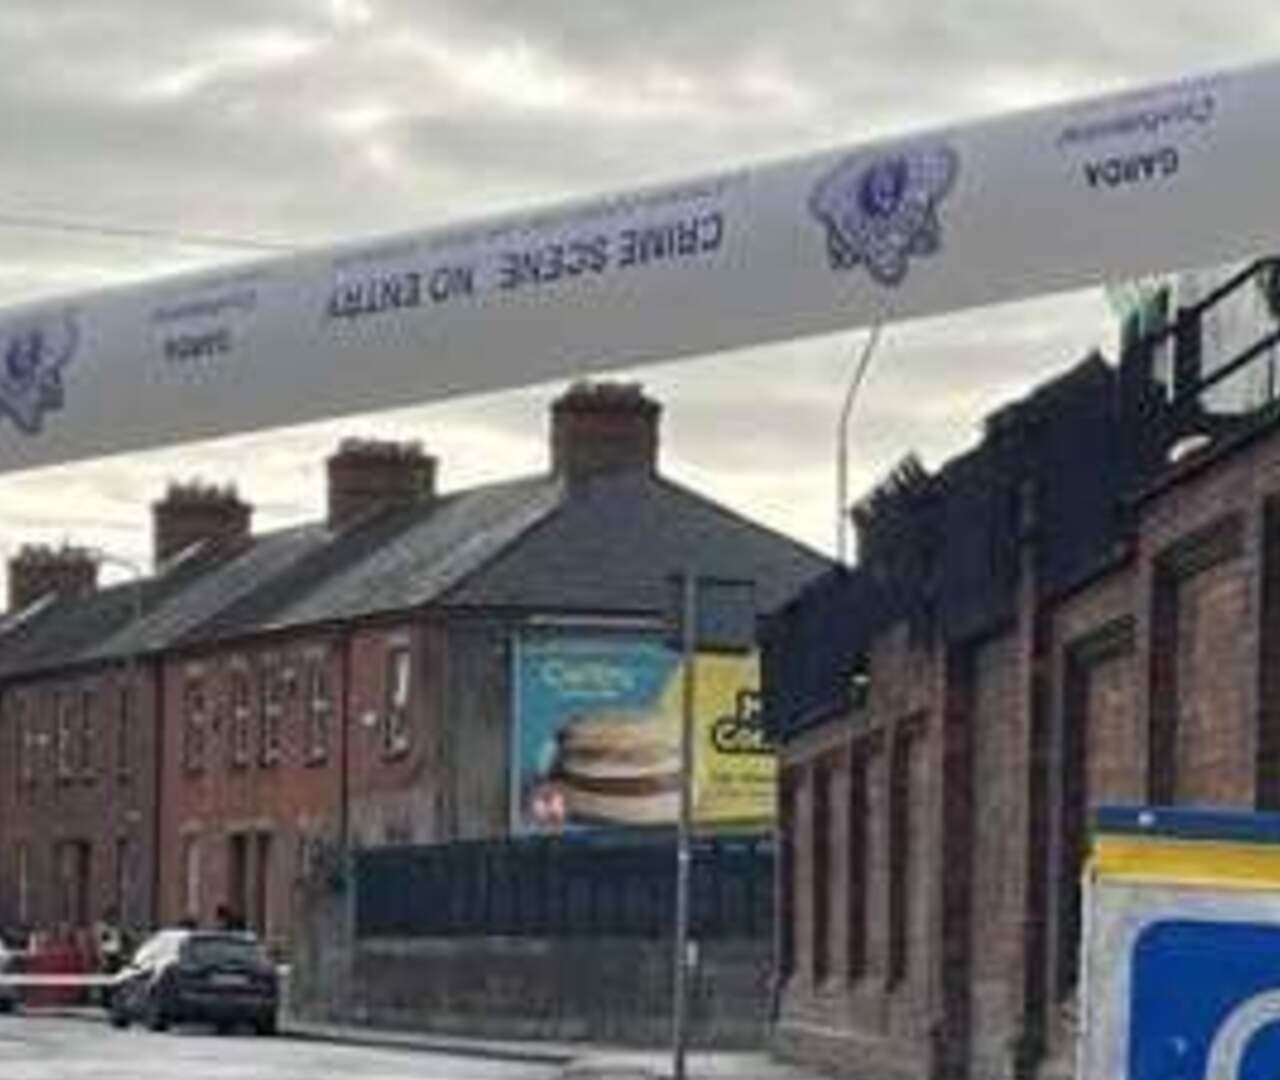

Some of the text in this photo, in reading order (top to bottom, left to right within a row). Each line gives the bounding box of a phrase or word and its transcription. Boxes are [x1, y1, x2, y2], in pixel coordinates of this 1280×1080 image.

[1084, 147, 1179, 187] GARDA
[498, 238, 608, 290] SCENE
[618, 212, 721, 267] CRIME
[326, 268, 421, 318] ENTRY
[428, 263, 475, 303] NO
